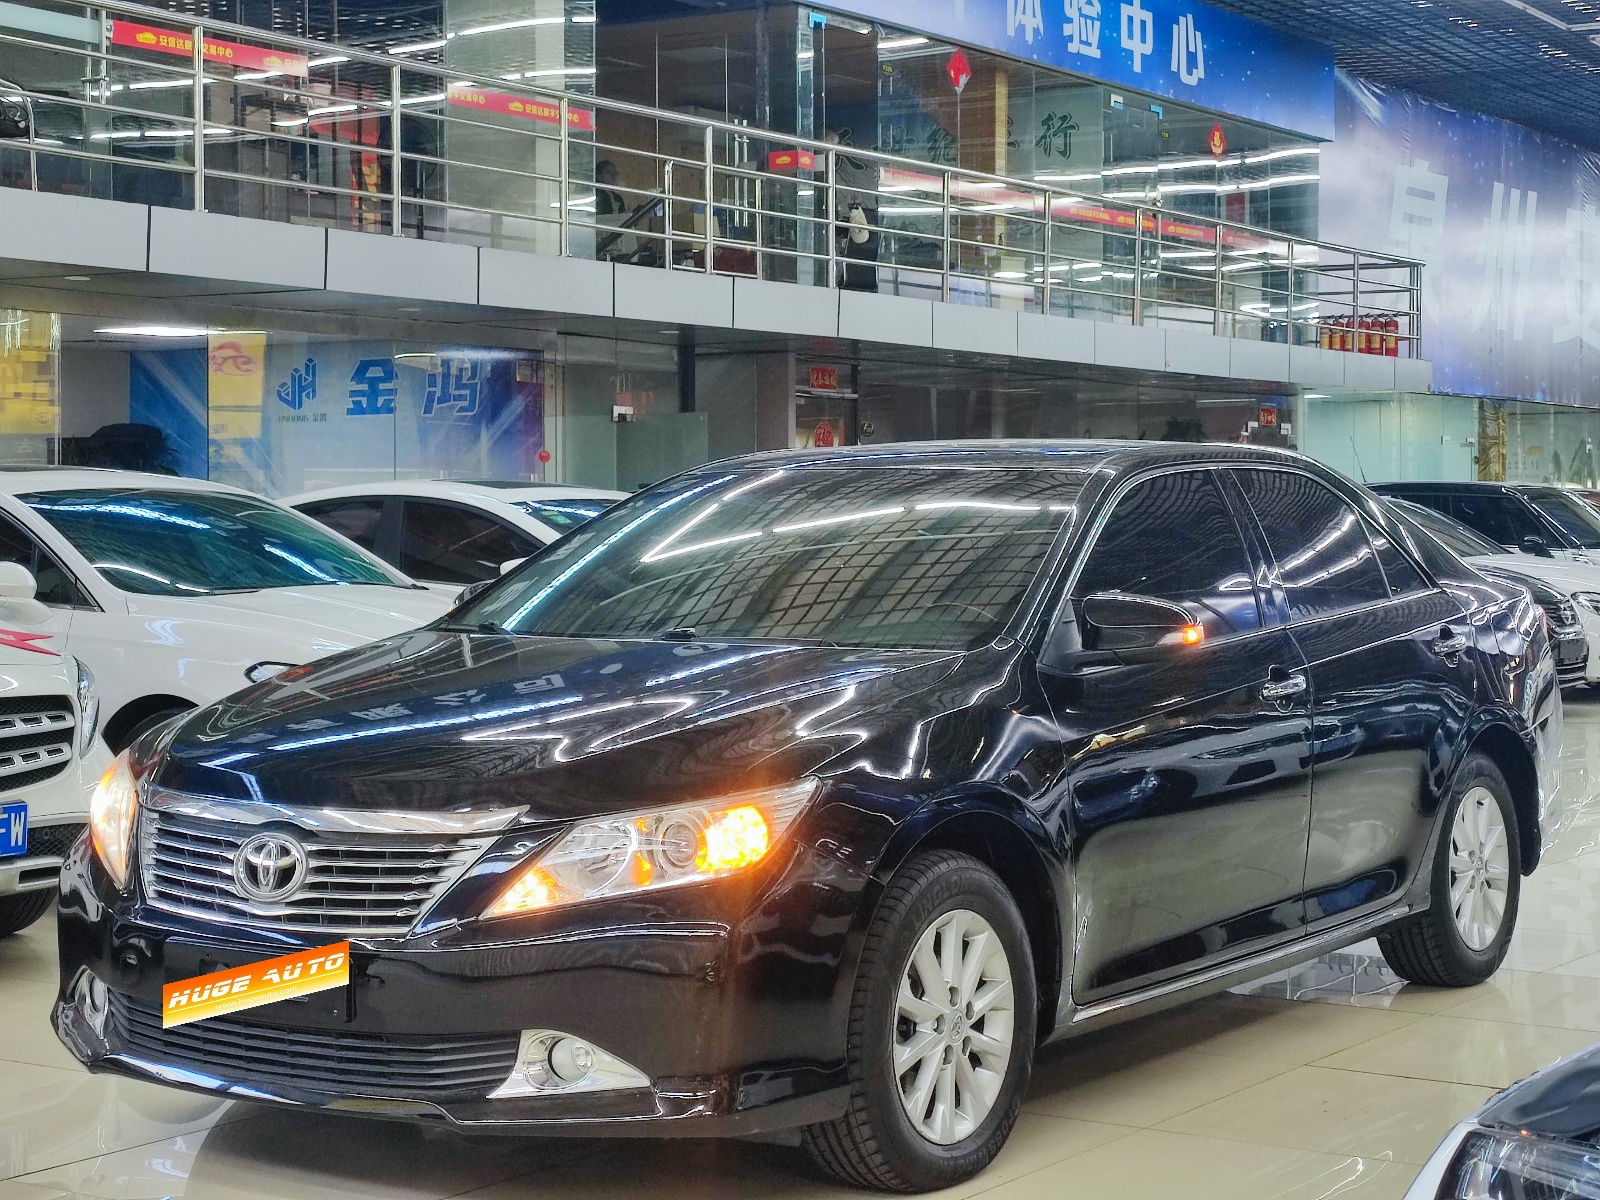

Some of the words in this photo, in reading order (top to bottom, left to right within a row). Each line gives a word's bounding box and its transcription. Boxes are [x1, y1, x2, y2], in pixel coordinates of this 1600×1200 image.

[160, 35, 233, 58] 安信达数交易中心
